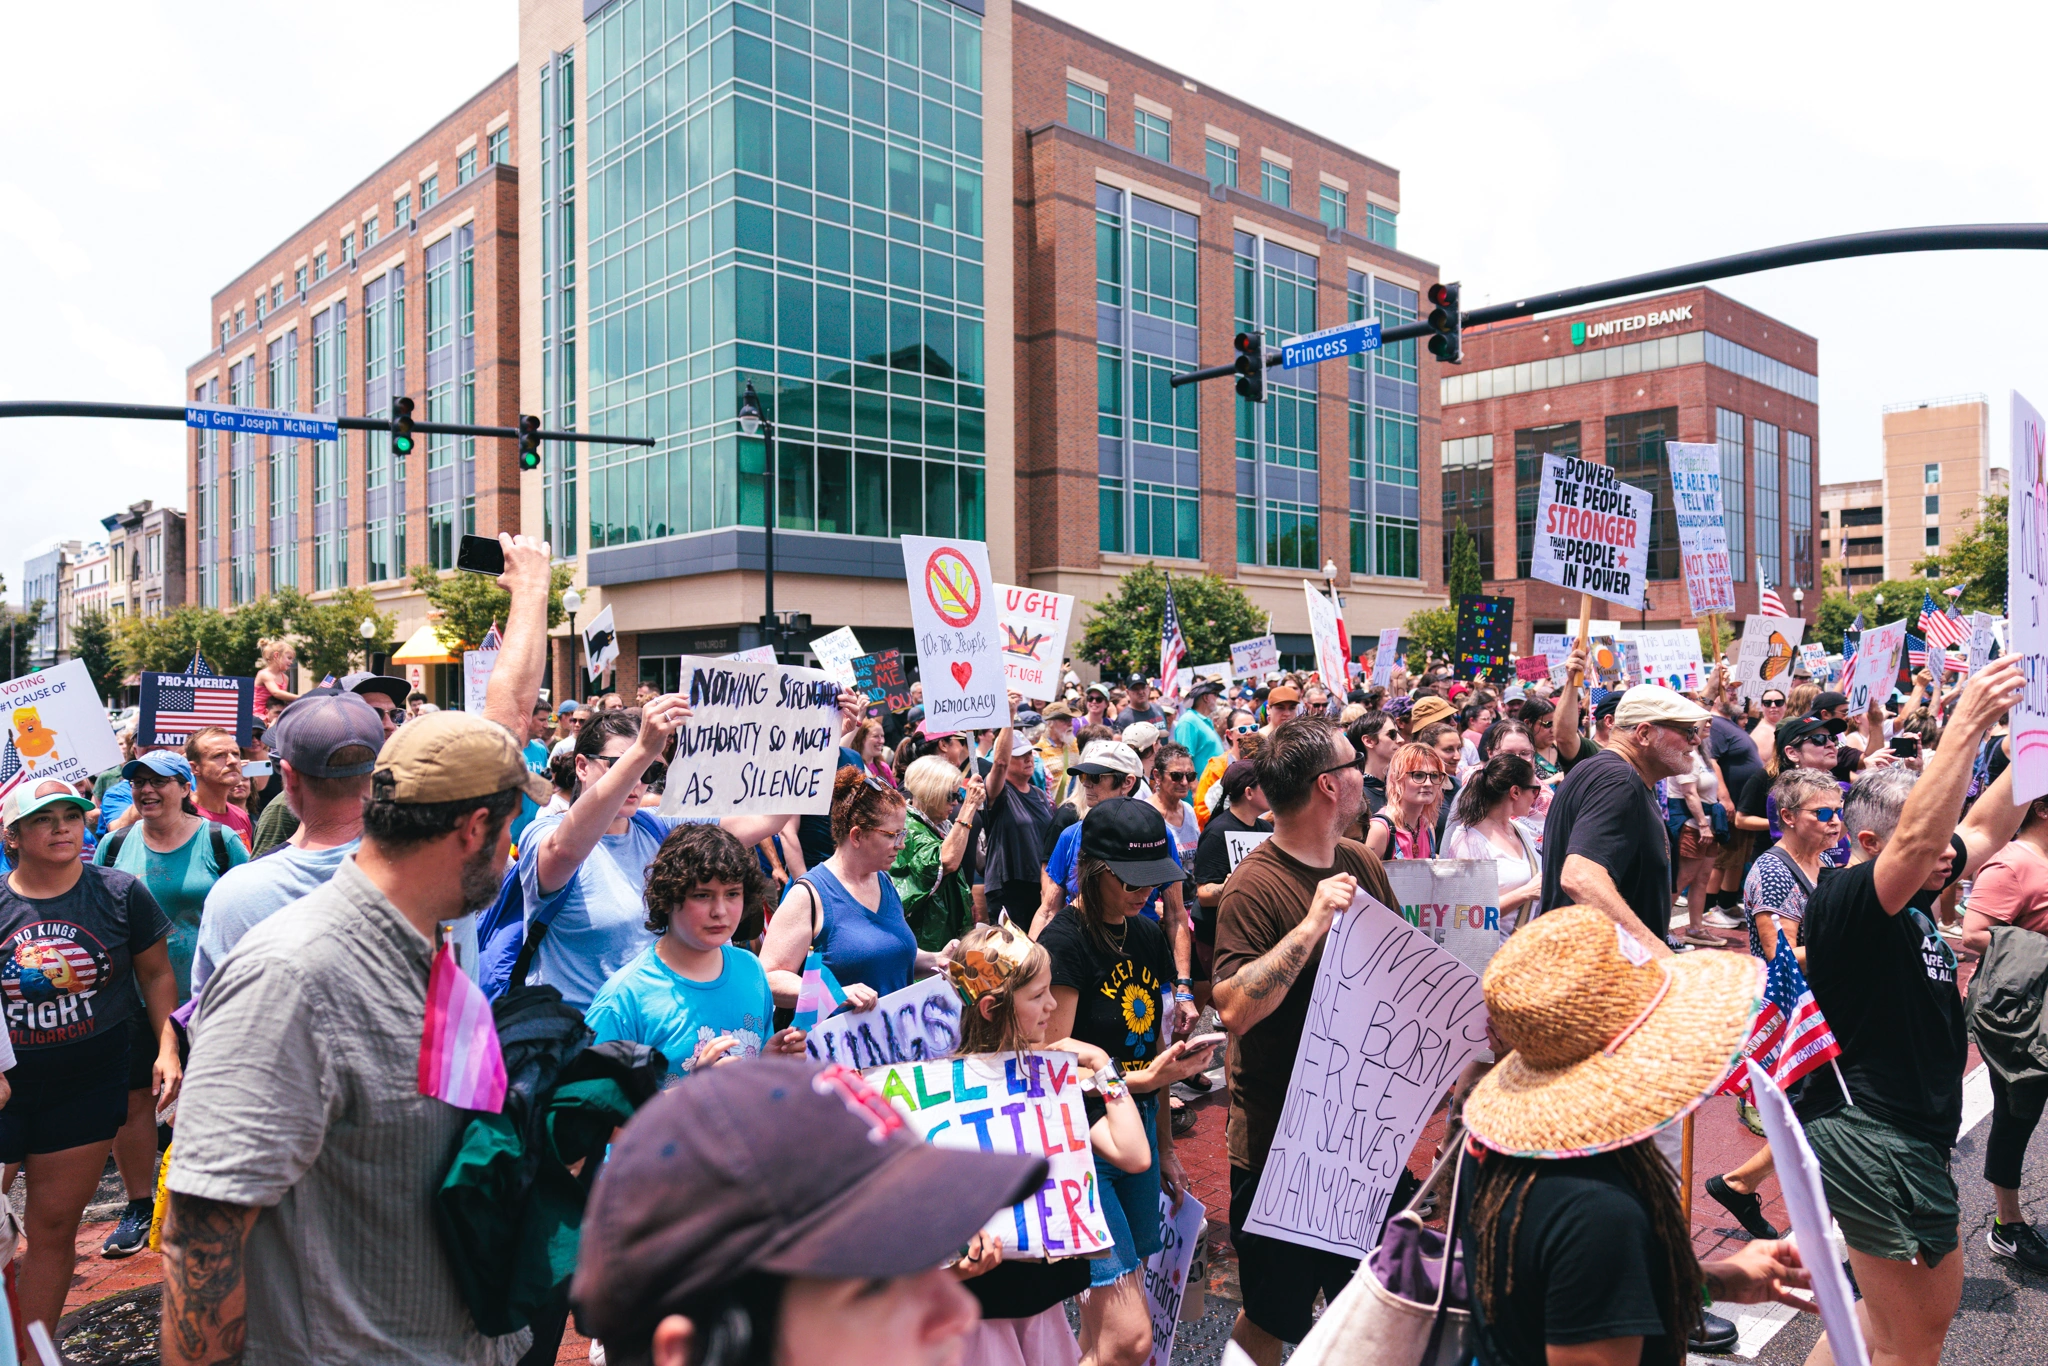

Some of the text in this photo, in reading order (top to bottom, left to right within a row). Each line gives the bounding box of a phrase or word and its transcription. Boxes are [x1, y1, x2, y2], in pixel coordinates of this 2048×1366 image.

[1301, 323, 1356, 341] DOWNTOWN WILMINGTON
[1587, 305, 1693, 338] UNITED BANK
[1363, 327, 1373, 338] St
[1286, 338, 1348, 366] Princess
[1361, 337, 1378, 350] 300
[187, 409, 336, 434] Maj Gen Joseph McNeil Way
[235, 407, 280, 416] COMMEMORATIVE
[2024, 420, 2035, 488] NO
[1553, 457, 1621, 491] THE POWER OF
[1672, 471, 1720, 492] BE ABLE TO
[1554, 480, 1637, 519] THE PEOPLE IS
[1681, 492, 1715, 513] TELL MY
[1546, 503, 1637, 549] STRONGER
[1678, 514, 1724, 528] GRANDCHILDREN
[1549, 536, 1566, 549] THAN
[1553, 538, 1616, 569] THE PEOPLE
[1684, 552, 1730, 577] NOT STAY
[1562, 562, 1631, 596] IN POWER
[1688, 575, 1734, 610] SILENT
[1006, 588, 1060, 621] UGH.
[1472, 602, 1499, 613] JUST
[1475, 615, 1495, 626] SAY
[1749, 618, 1776, 637] NO
[837, 635, 852, 650] NOT
[1477, 628, 1492, 638] NO
[1601, 636, 1613, 646] NO
[1638, 634, 1659, 648] This
[1661, 633, 1681, 648] Land
[921, 631, 938, 658] We
[954, 631, 988, 657] People
[1232, 639, 1272, 654] DEMOCRACY
[1479, 639, 1487, 649] 2
[1741, 639, 1783, 657] HUMAN
[1806, 644, 1818, 652] NO
[1863, 634, 1875, 658] WE
[853, 649, 900, 668] THIS LAND
[1250, 662, 1258, 670] NO
[1260, 657, 1277, 668] KINGS
[1461, 652, 1504, 665] FASCISM
[1644, 650, 1700, 662] Your Land This Land
[1803, 650, 1825, 661] FAUX
[1806, 658, 1827, 668] KING
[854, 666, 872, 678] WAS
[874, 660, 899, 673] MADE
[1003, 664, 1044, 685] ST. UGH.
[1738, 660, 1755, 680] IS
[1810, 666, 1829, 677] WAY
[1870, 659, 1879, 675] TO
[0, 674, 46, 696] VOTING
[157, 675, 239, 690] PRO-AMERICA
[689, 667, 768, 709] NOTHING
[857, 679, 873, 689] FOR
[876, 667, 904, 688] ME
[0, 681, 67, 712] #1 CAUSE OF
[867, 687, 912, 711] ND YOU
[1852, 684, 1868, 710] NO
[933, 693, 996, 724] DEMOCRACY
[675, 722, 832, 760] AUTHORITY SO MUCH
[681, 761, 824, 806] AS SILENCE
[1454, 904, 1499, 931] FOR
[13, 923, 78, 946] NO KINGS
[1100, 960, 1160, 1000] KEEP UP
[6, 990, 98, 1030] FIGHT
[1306, 973, 1471, 1089] ARE BORN
[881, 1058, 988, 1112] ALL
[1279, 1088, 1405, 1178] NOT SLAVES
[1257, 1147, 1393, 1251] TO ANY REGIME
